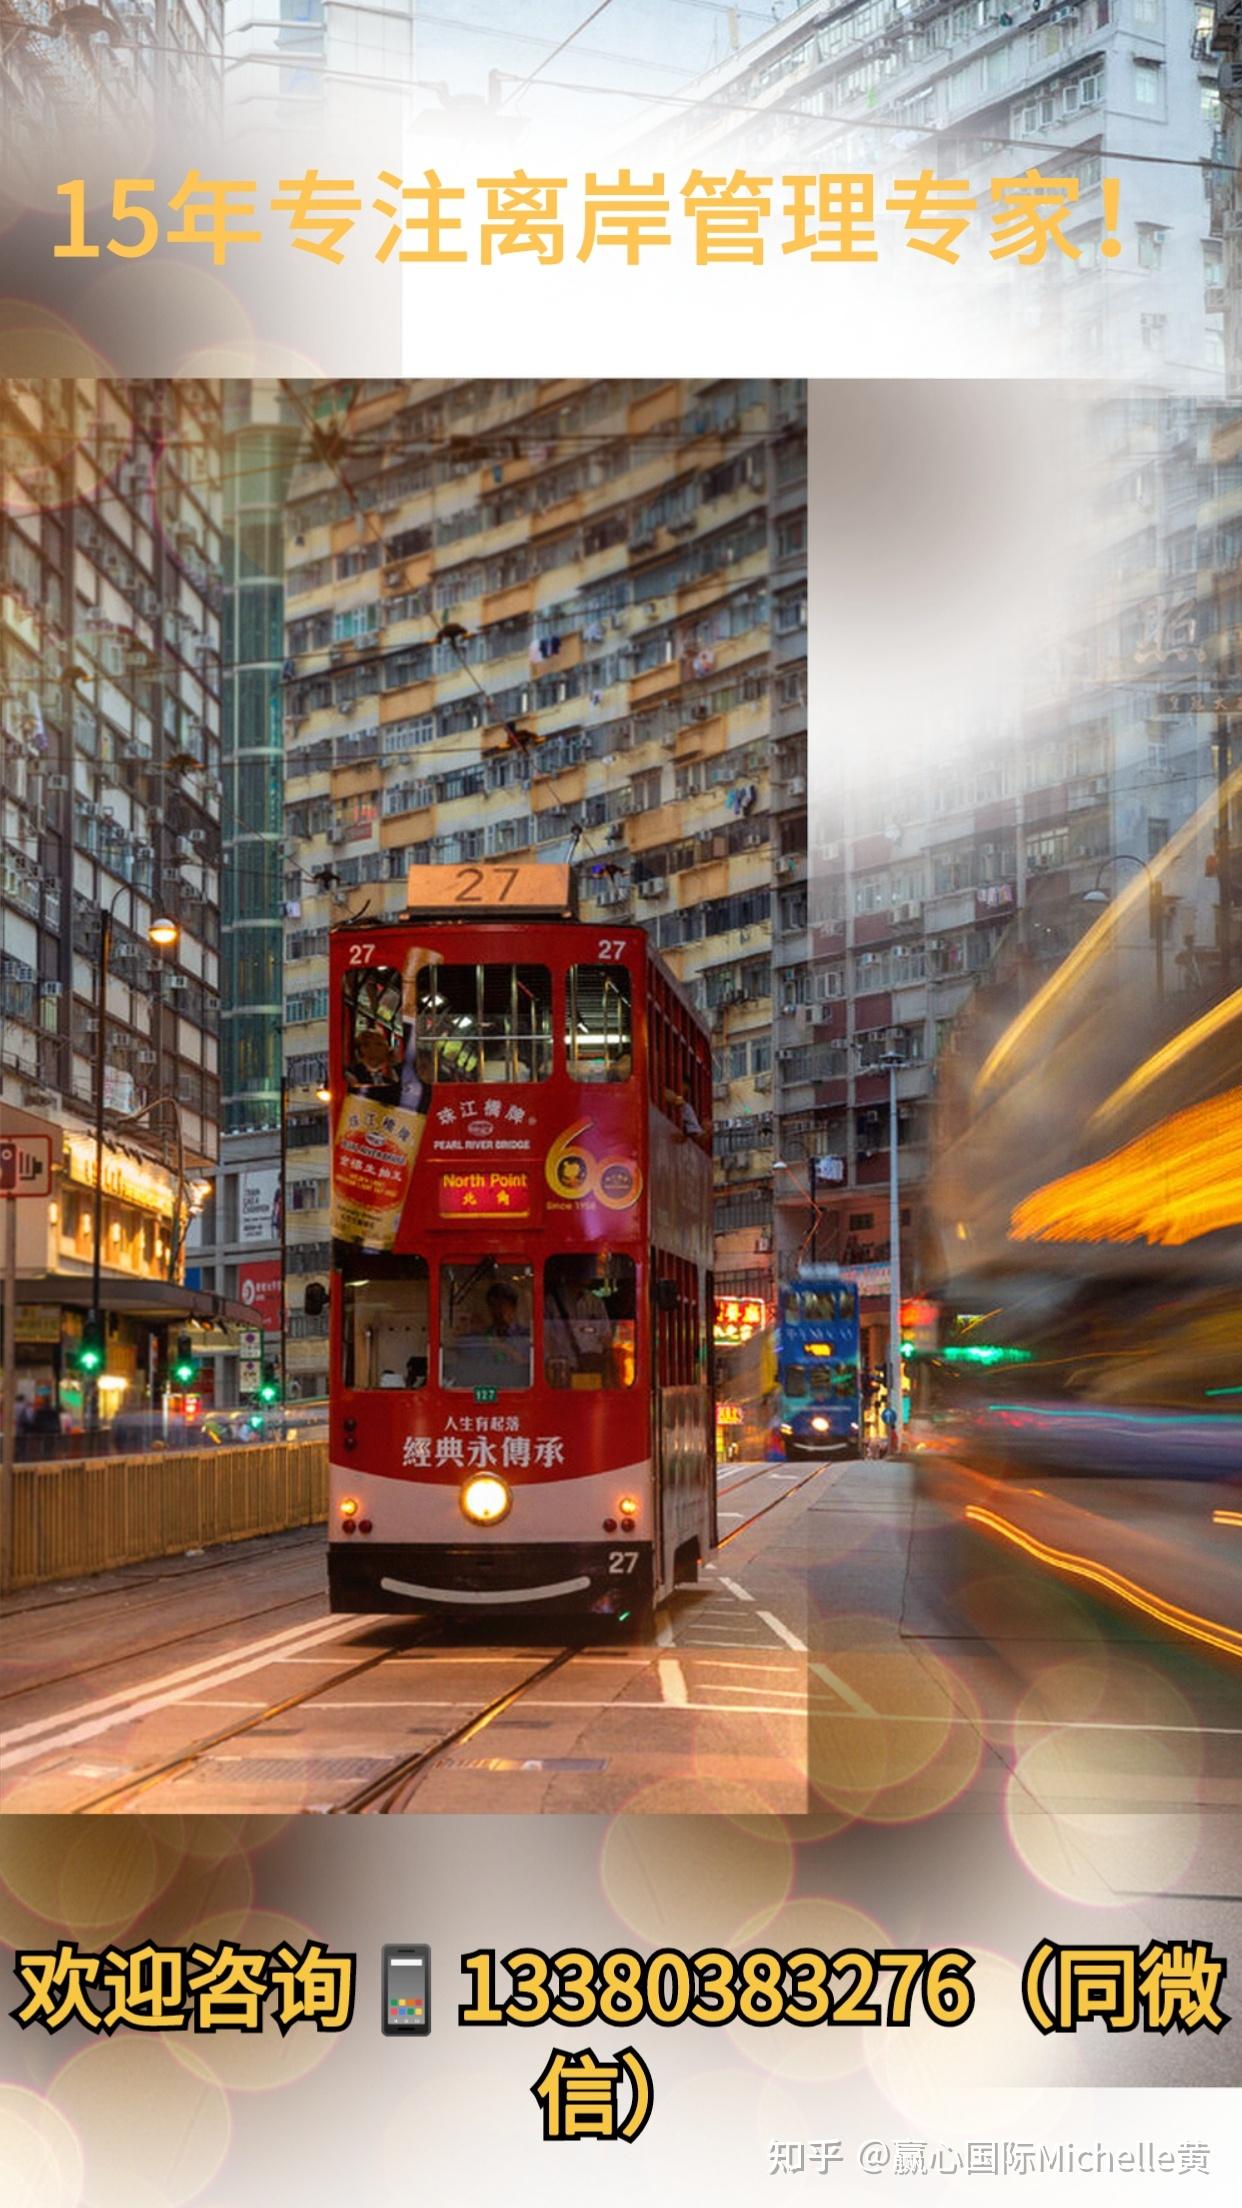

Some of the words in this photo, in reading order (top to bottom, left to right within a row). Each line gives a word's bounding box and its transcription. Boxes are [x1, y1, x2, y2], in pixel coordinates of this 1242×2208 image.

[455, 867, 519, 902] 27
[349, 944, 375, 965] 27
[598, 939, 626, 960] 27
[436, 1098, 526, 1125] 珠江橋牌
[433, 1140, 464, 1150] PEARL
[465, 1140, 493, 1150] RIVER
[495, 1140, 531, 1150] BRIDGE
[443, 1173, 485, 1188] North
[490, 1172, 528, 1188] Point
[476, 1389, 496, 1401] 127
[402, 1435, 565, 1468] 經典永傳承
[608, 1551, 639, 1574] 27
